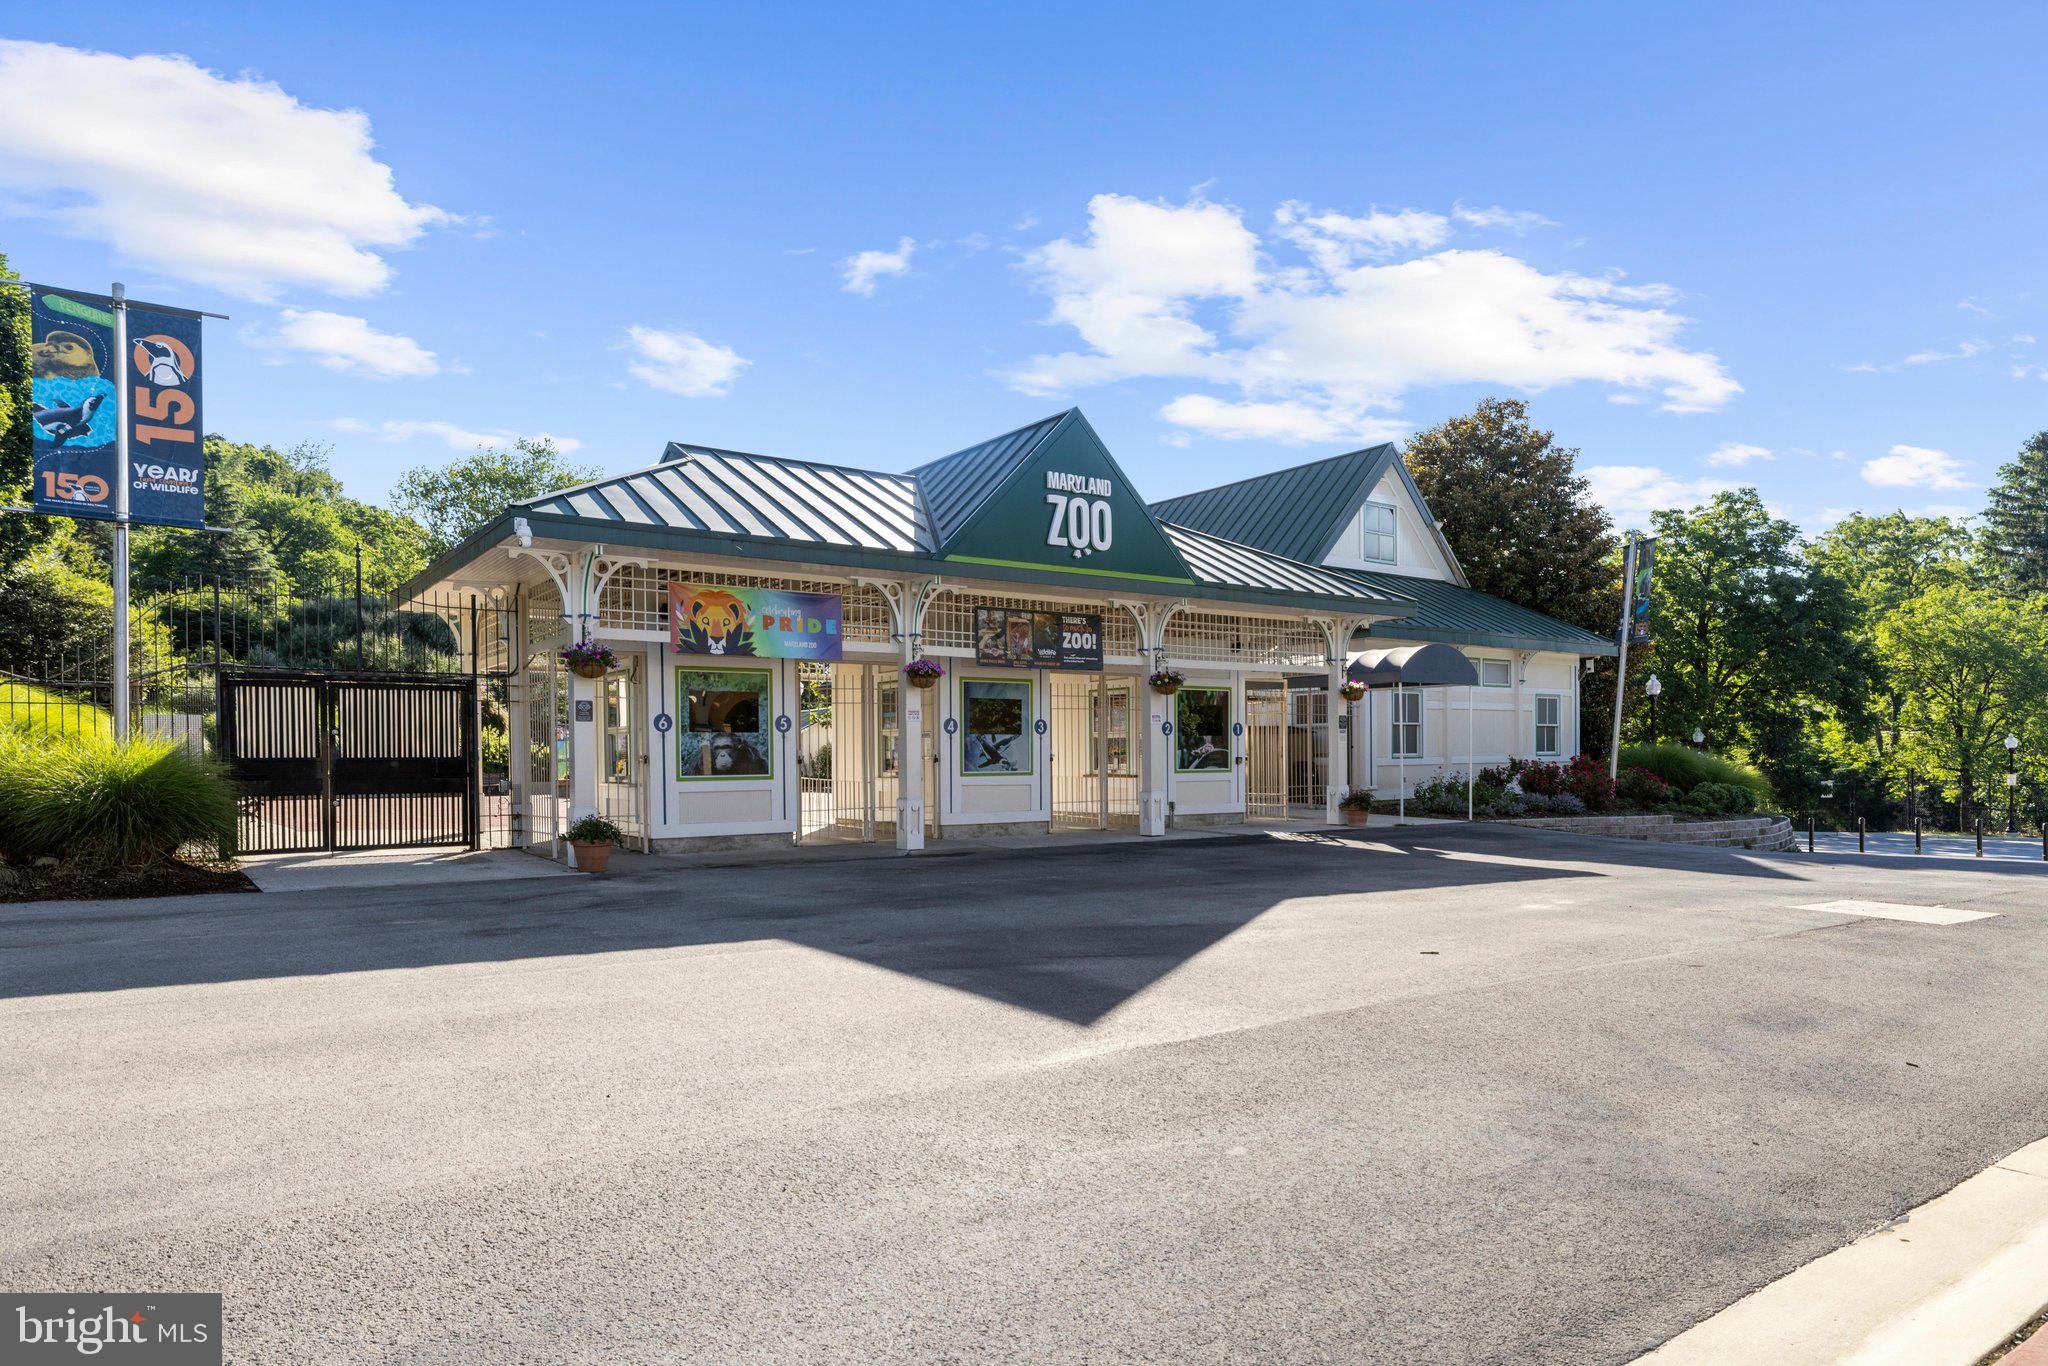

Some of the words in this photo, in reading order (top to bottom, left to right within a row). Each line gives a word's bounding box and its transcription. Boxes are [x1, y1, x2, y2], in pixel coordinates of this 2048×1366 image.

[42, 470, 109, 502] 150
[133, 481, 148, 490] OF
[1046, 470, 1112, 497] MARYLAND
[1046, 494, 1112, 551] ZOO
[763, 615, 837, 635] PRIDE
[1062, 616, 1087, 625] THERE'S
[1063, 632, 1097, 650] ZOO!
[658, 716, 668, 730] 6
[779, 717, 788, 730] 5
[947, 720, 955, 732] 4
[1037, 721, 1044, 732] 3
[1164, 721, 1171, 734] 2
